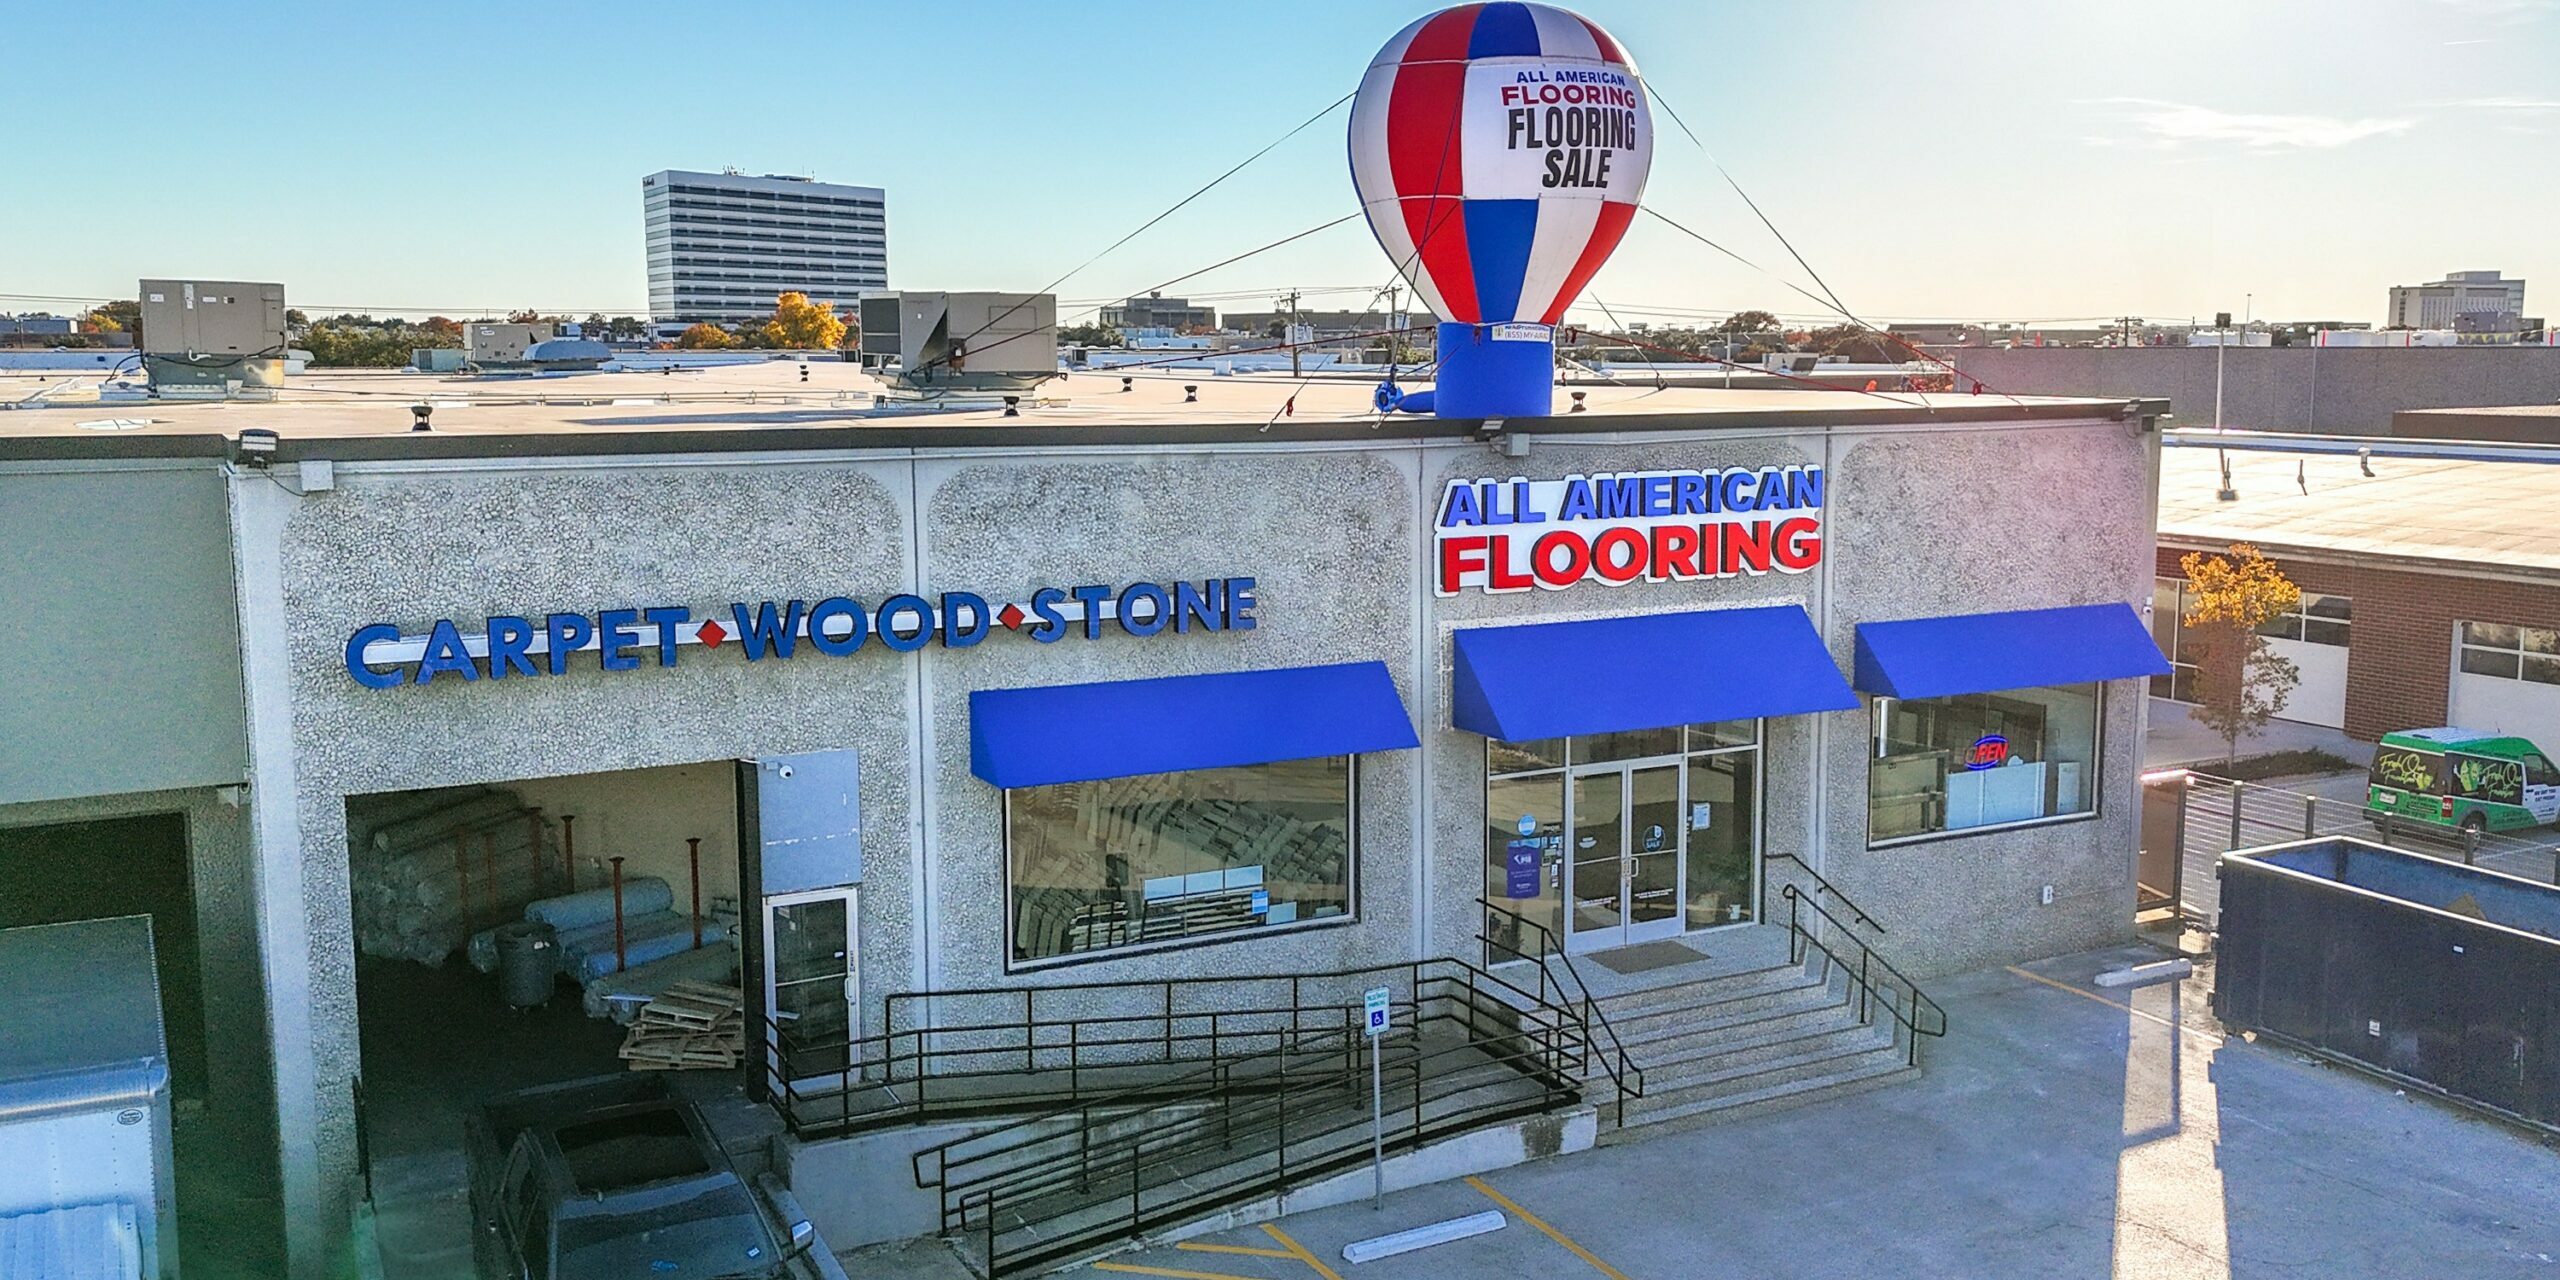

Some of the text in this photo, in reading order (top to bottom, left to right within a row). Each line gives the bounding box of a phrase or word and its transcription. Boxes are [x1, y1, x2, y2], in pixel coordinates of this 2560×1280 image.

[1501, 84, 1635, 108] FLOORING
[1517, 71, 1625, 86] ALL AMERICAN
[1508, 106, 1635, 151] FLOORING
[1542, 149, 1612, 188] SALE
[1440, 470, 1824, 528] ALL AMERICAN
[1440, 517, 1822, 593] FLOORING
[345, 577, 1257, 689] CARPET WOOD STONE
[1965, 742, 2009, 763] OPEN
